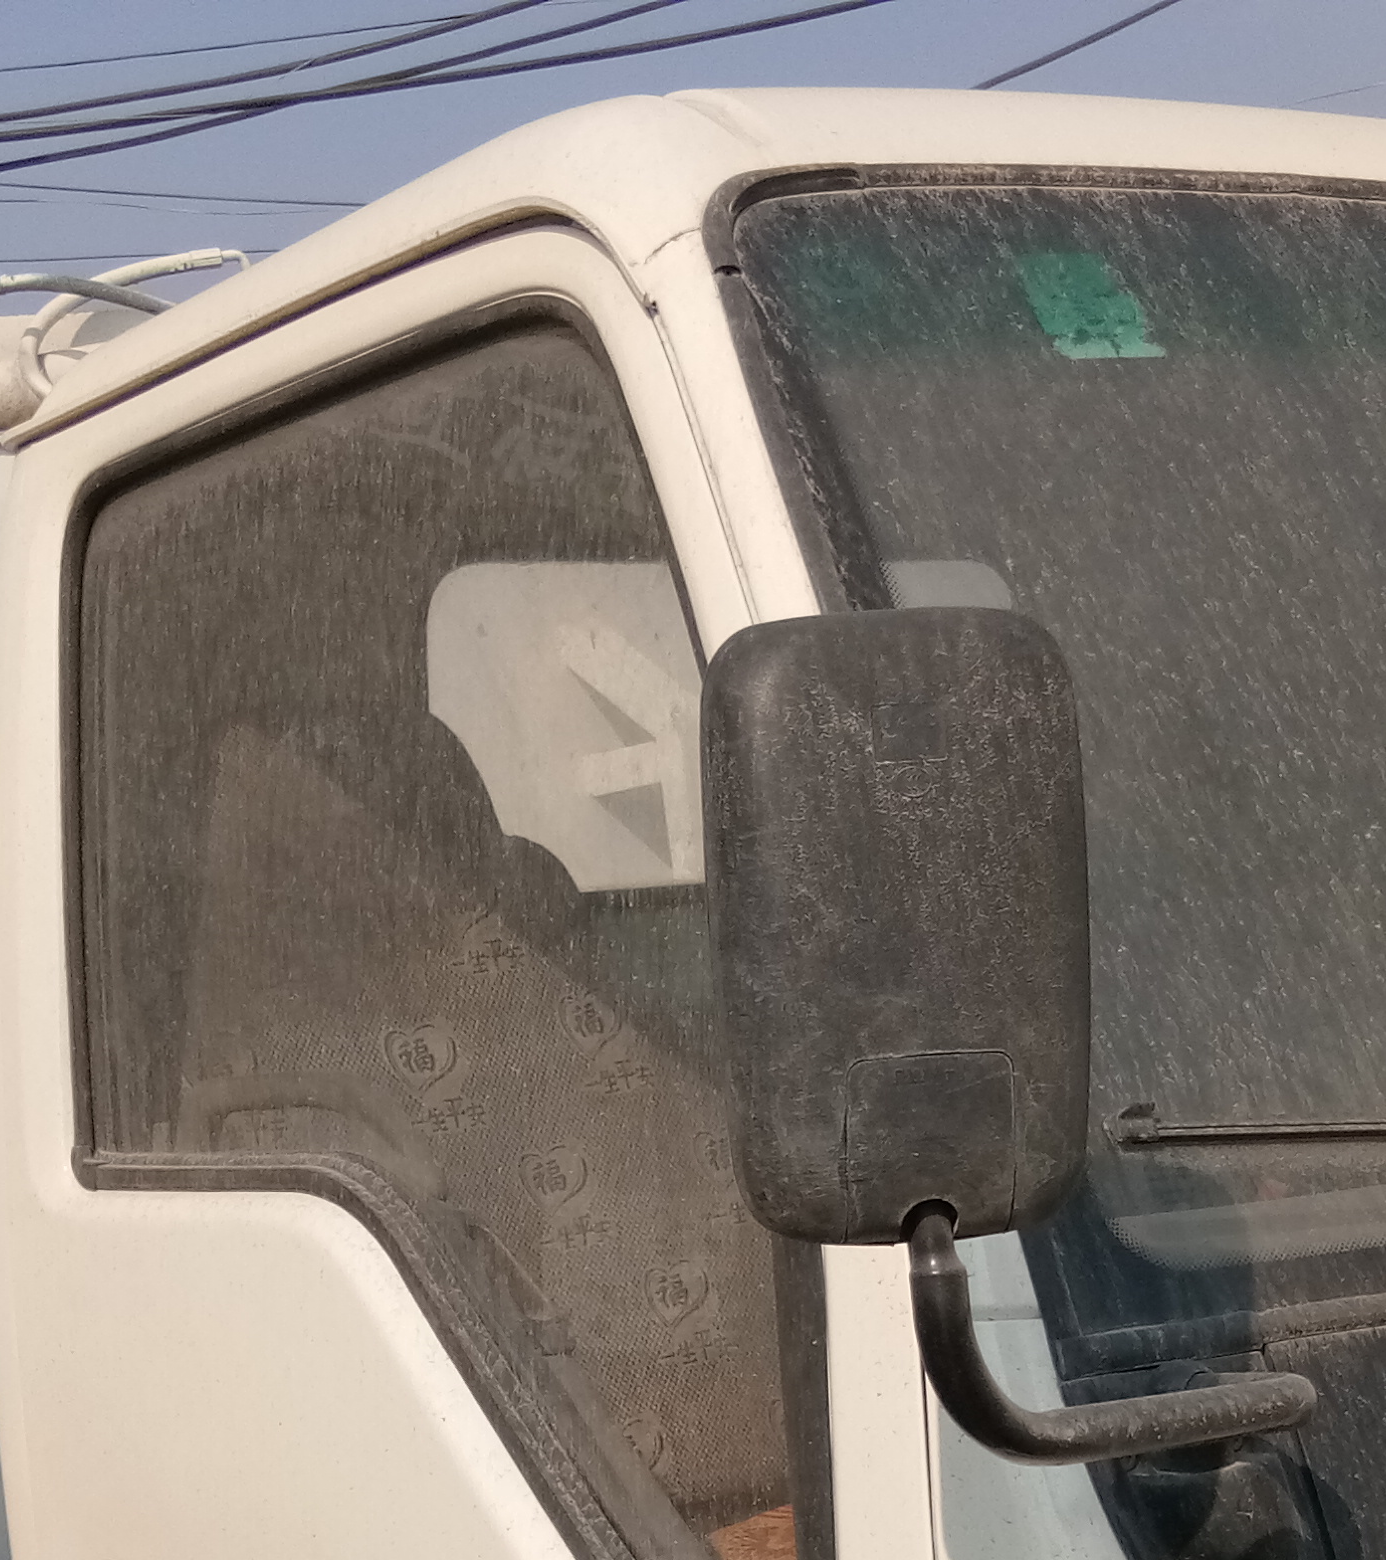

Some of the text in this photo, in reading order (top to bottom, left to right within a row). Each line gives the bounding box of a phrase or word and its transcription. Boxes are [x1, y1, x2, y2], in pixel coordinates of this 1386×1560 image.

[574, 1002, 604, 1038] 福
[398, 1038, 436, 1074] 福
[584, 1059, 654, 1095] 一生平安
[411, 1096, 485, 1132] 一生平安
[532, 1160, 567, 1194] 福
[540, 1214, 613, 1250] 一生平安
[655, 1273, 688, 1309] 福
